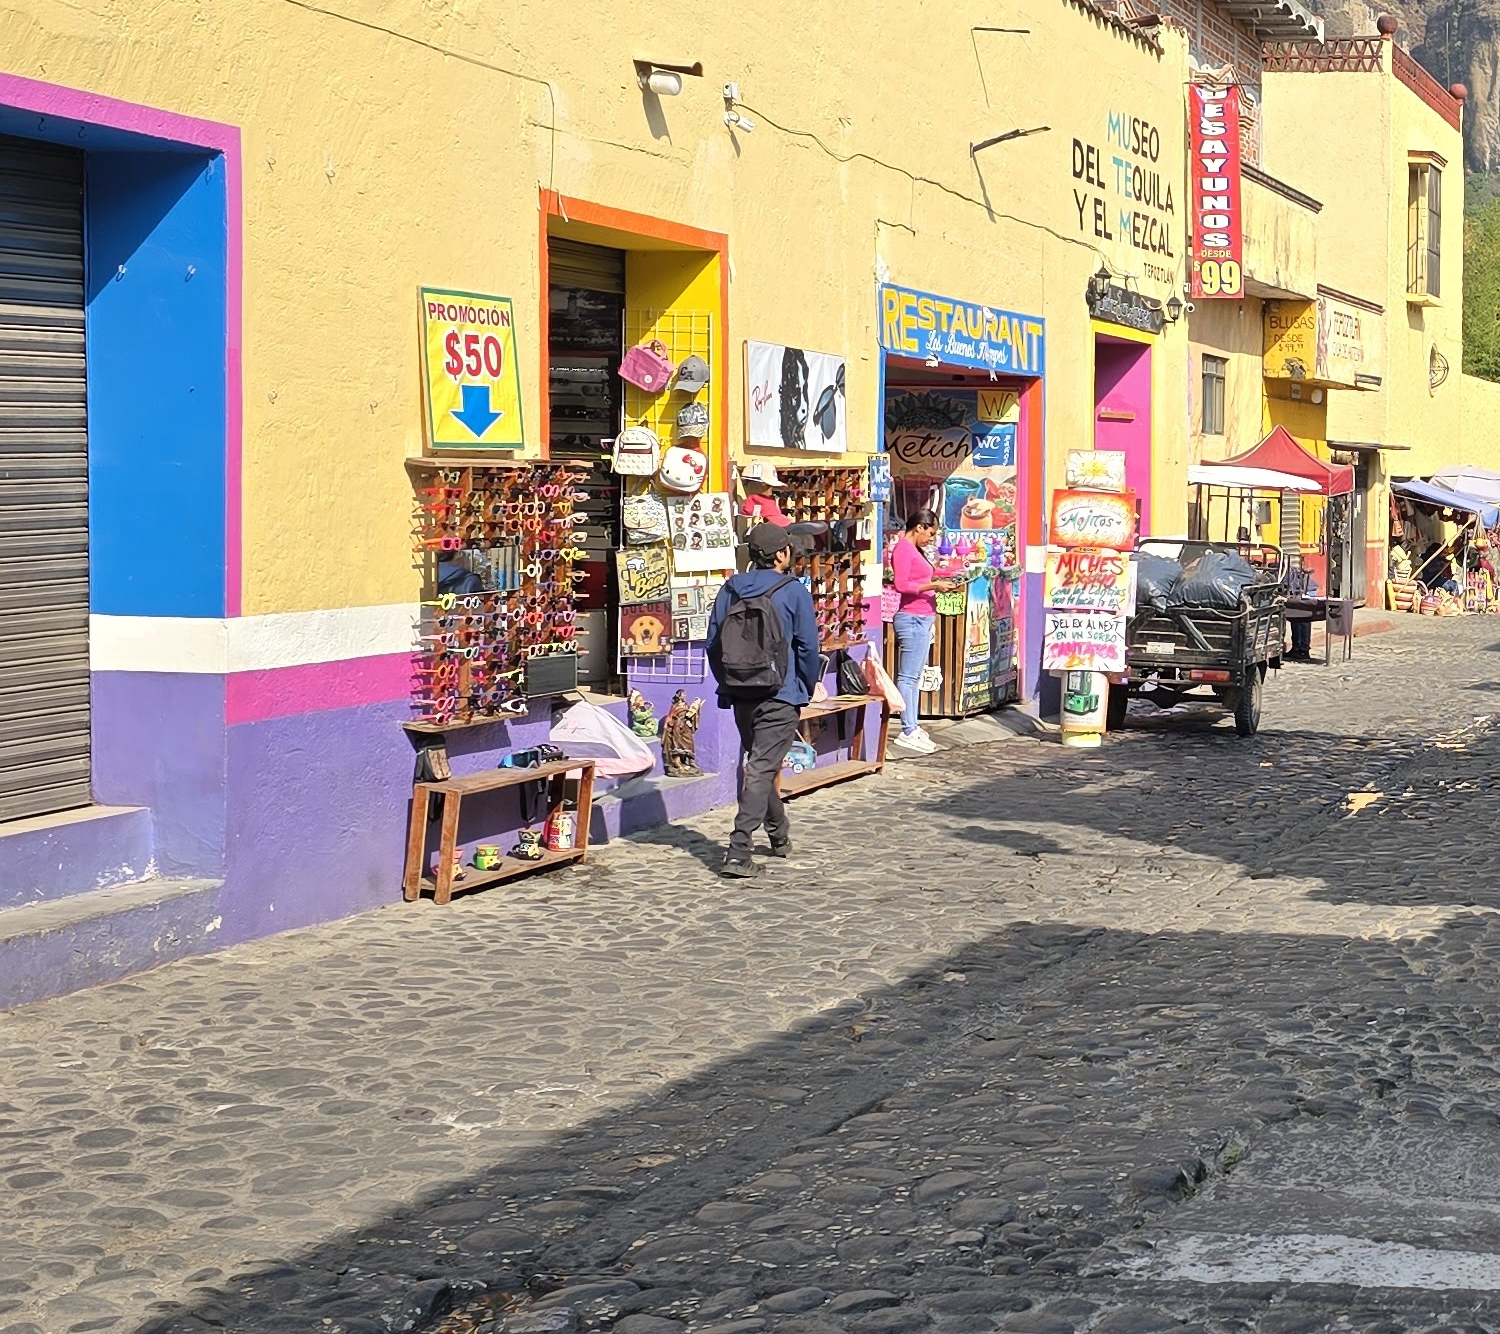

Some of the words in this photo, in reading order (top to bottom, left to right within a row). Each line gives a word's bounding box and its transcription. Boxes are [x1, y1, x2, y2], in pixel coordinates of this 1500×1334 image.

[1107, 109, 1160, 163] MUSEO
[1072, 137, 1106, 189] DEL
[1112, 155, 1175, 216] TEQUILA
[1197, 87, 1232, 247] DESAYUNOS
[1073, 188, 1087, 231] Y
[1093, 197, 1113, 241] EL
[1119, 208, 1174, 258] MEZCAL
[1201, 249, 1232, 258] DESDE
[1193, 259, 1241, 295] $99
[428, 302, 511, 327] PROMOCIÓN
[882, 288, 1043, 371] RESTAURANT
[1269, 315, 1315, 329] BLUSAS
[925, 330, 943, 352] Los
[945, 332, 976, 359] Buenos
[1274, 334, 1304, 343] DESDE
[445, 329, 502, 381] $50
[975, 435, 1001, 449] WC
[1055, 554, 1124, 575] MICHES
